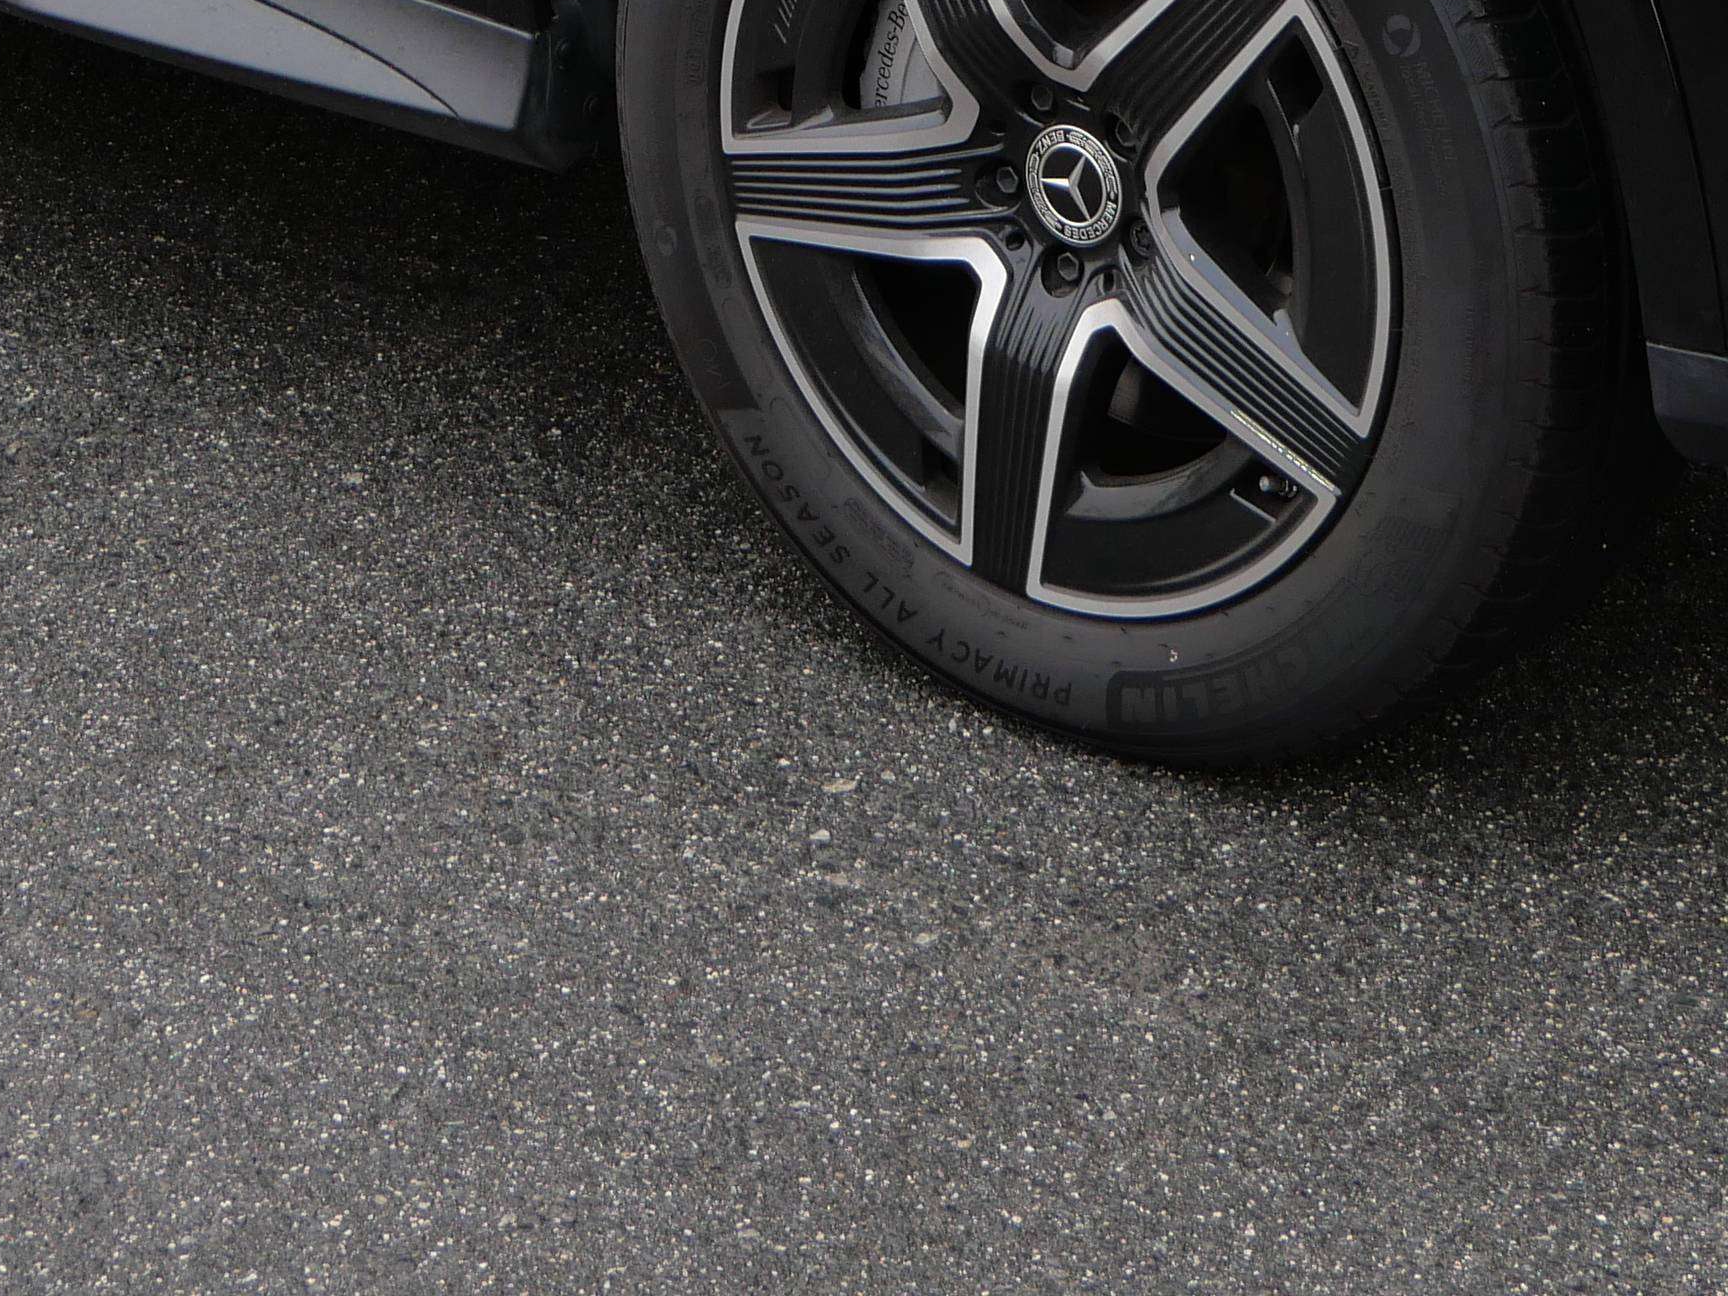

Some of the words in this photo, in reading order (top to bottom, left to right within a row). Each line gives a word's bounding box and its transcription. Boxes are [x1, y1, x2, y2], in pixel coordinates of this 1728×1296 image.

[874, 1, 913, 108] ercedes-Be
[1035, 129, 1065, 156] BENZ
[1063, 200, 1118, 241] MERCEDES
[742, 433, 852, 564] SEASON
[862, 570, 918, 625] ALL
[924, 627, 1074, 707] PRIMACY
